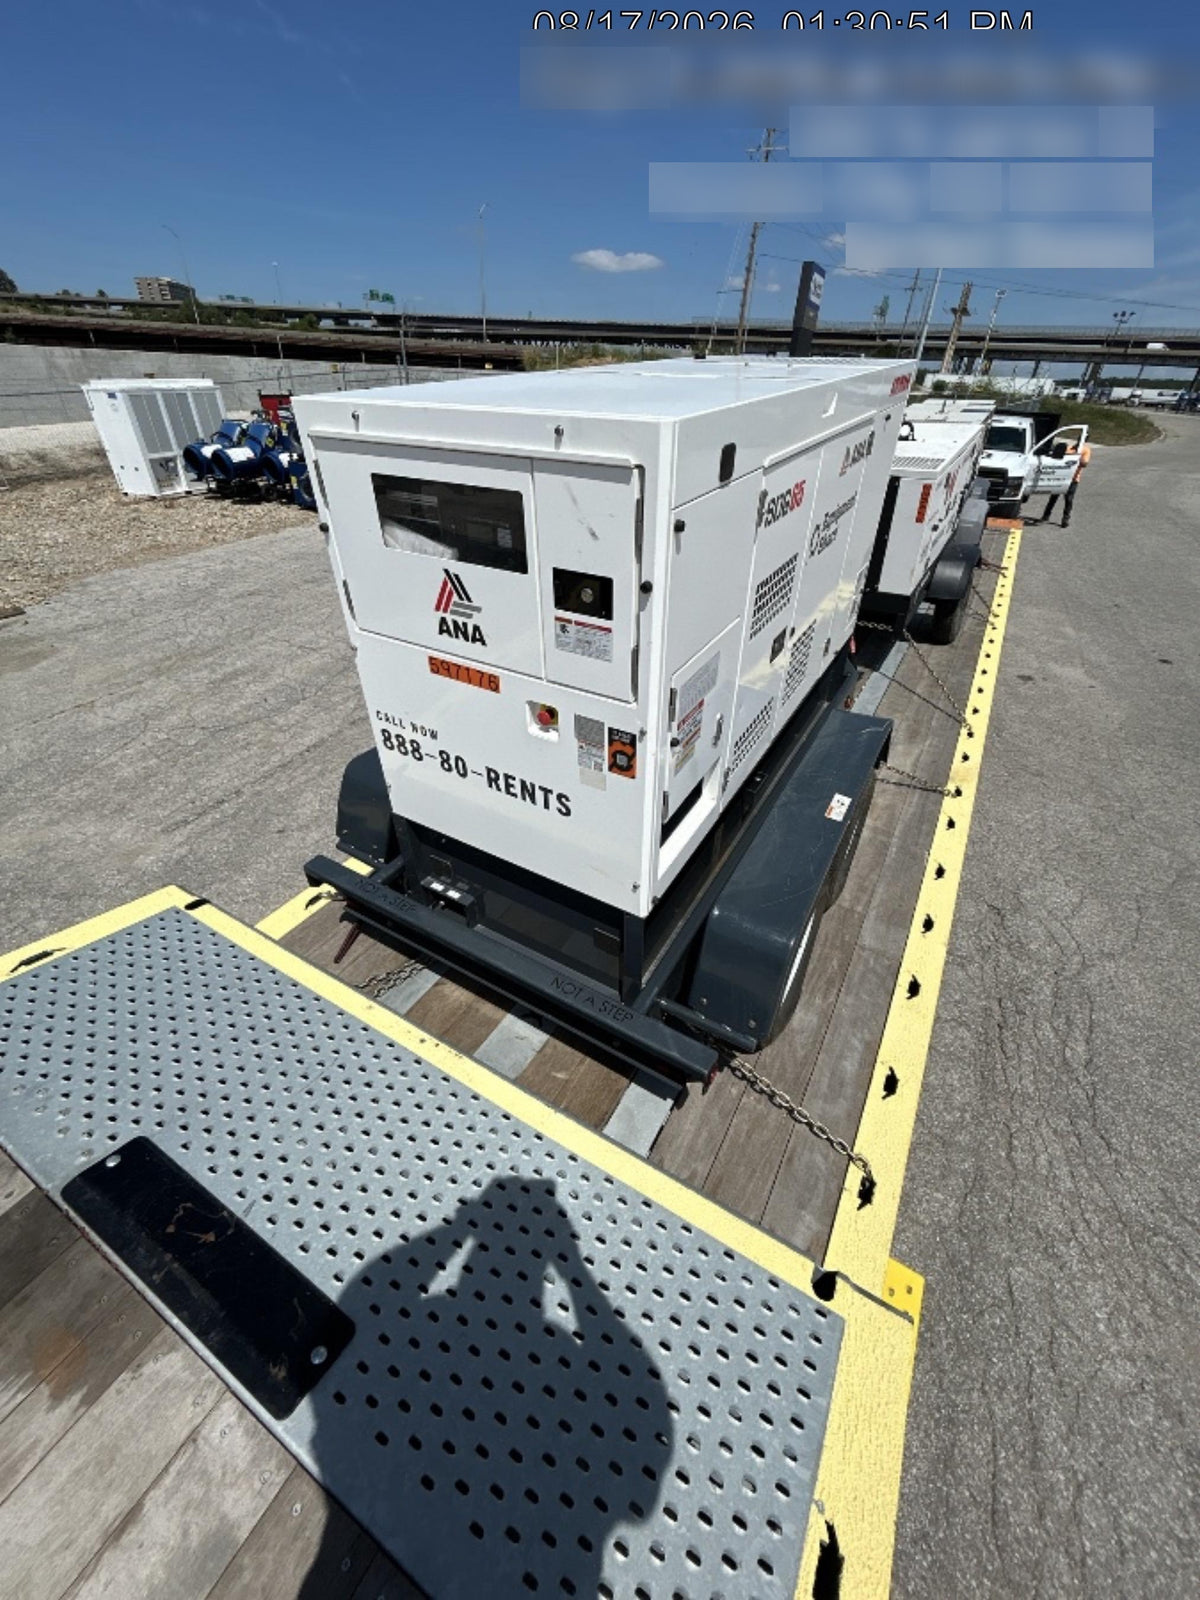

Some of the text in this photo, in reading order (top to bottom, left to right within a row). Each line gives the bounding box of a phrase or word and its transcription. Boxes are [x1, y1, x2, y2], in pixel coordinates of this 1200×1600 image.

[438, 616, 487, 647] ANA
[428, 656, 500, 693] 597176
[376, 710, 438, 740] CALL NOW
[381, 728, 572, 817] 888-80-RENTS
[550, 976, 634, 1022] NOT A STEP
